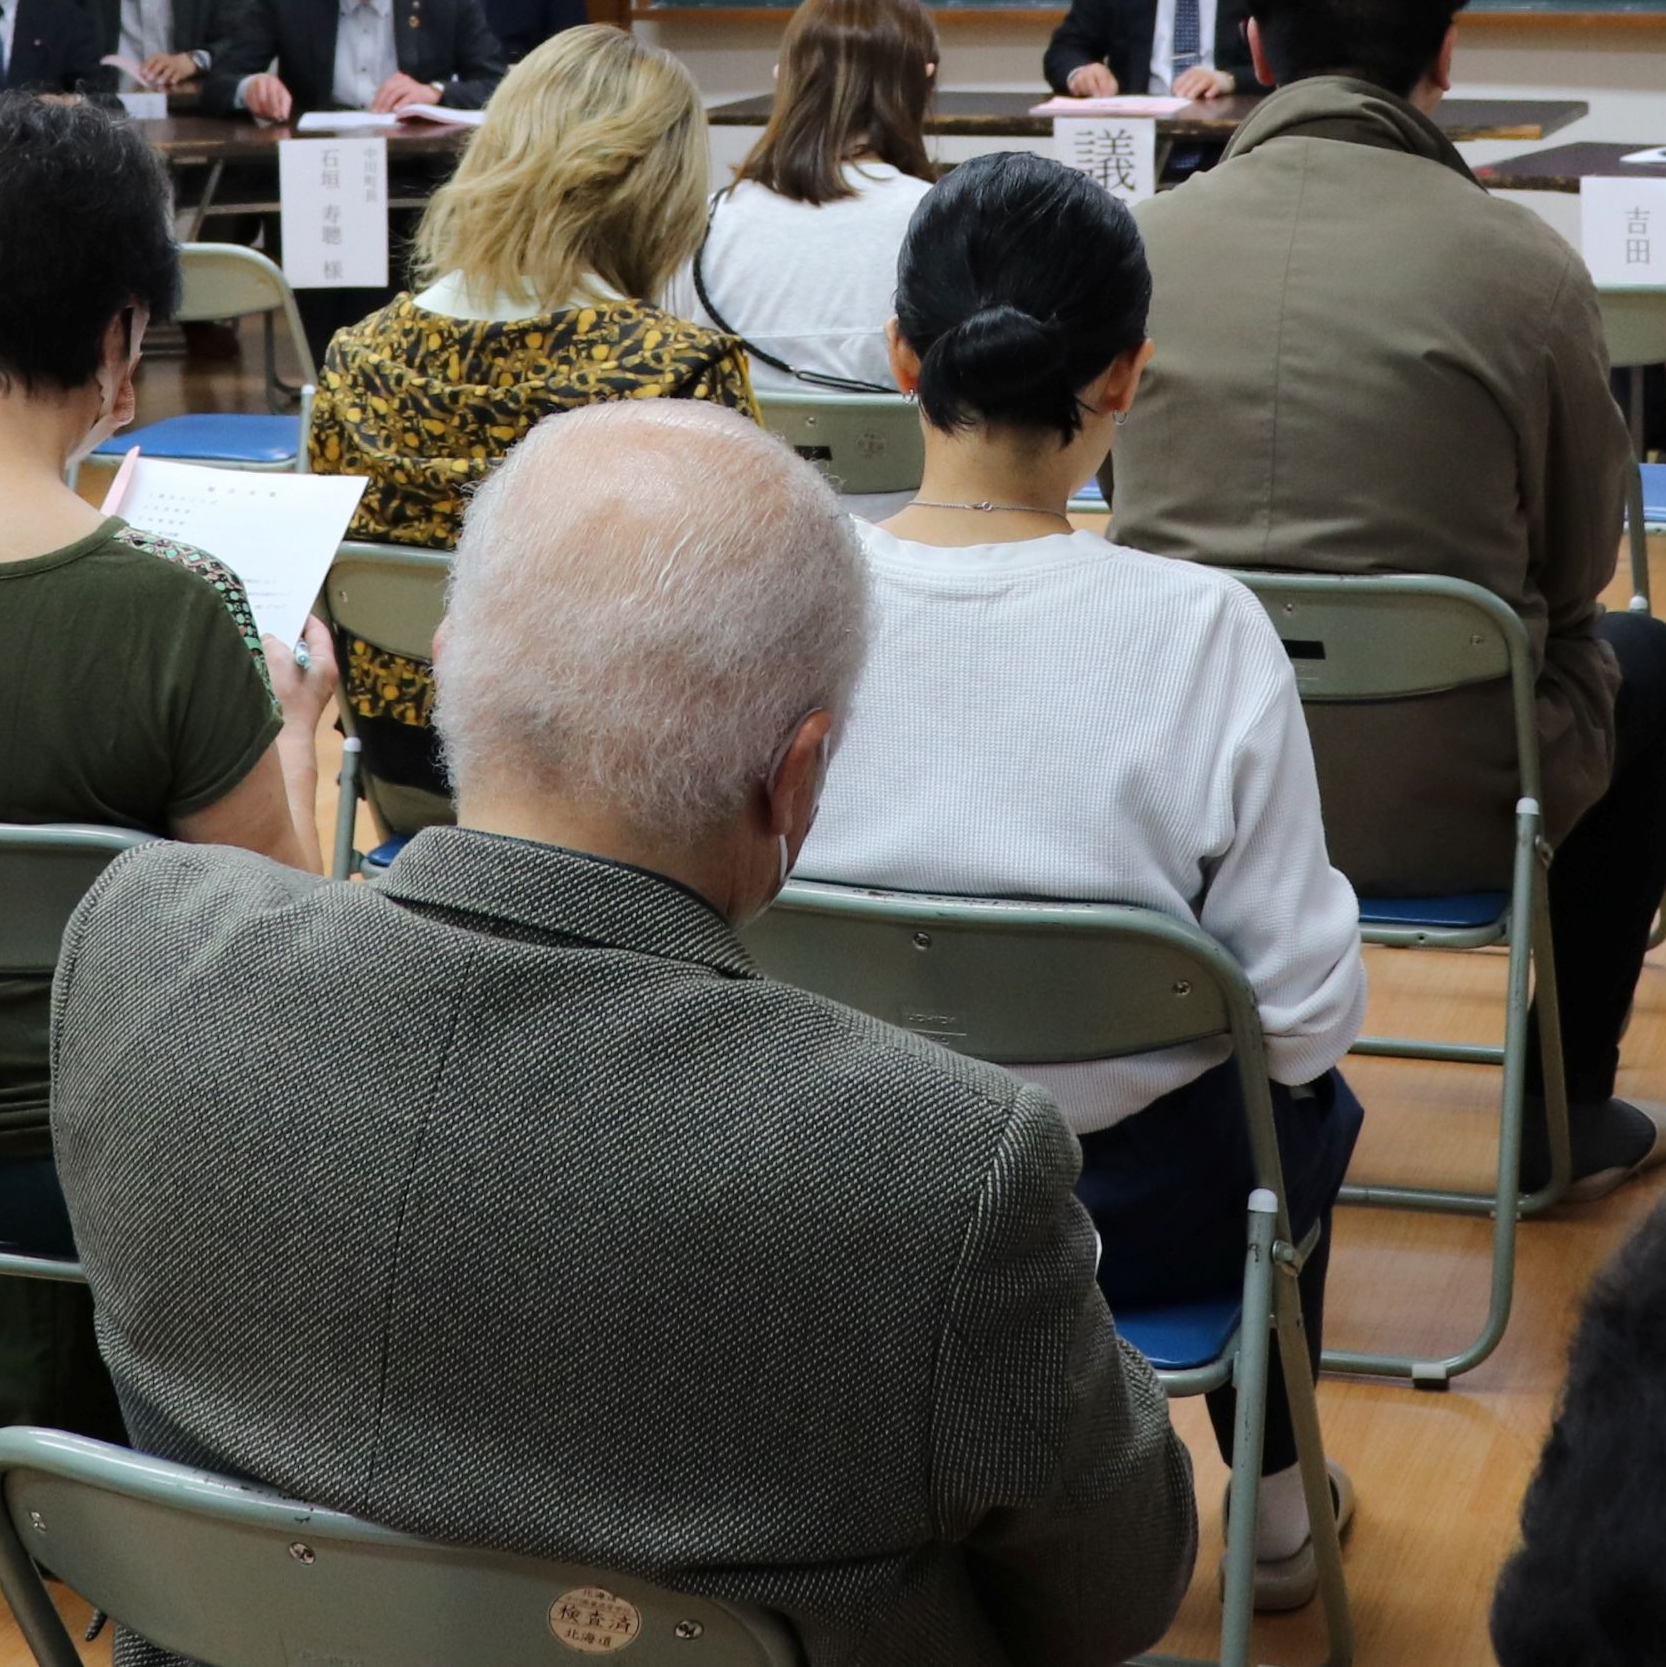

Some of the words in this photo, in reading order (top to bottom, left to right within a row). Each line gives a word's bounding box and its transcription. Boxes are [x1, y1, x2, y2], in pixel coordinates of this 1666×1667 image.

[1072, 128, 1136, 192] 議
[1624, 205, 1651, 265] 吉田
[560, 1603, 631, 1634] 検査済
